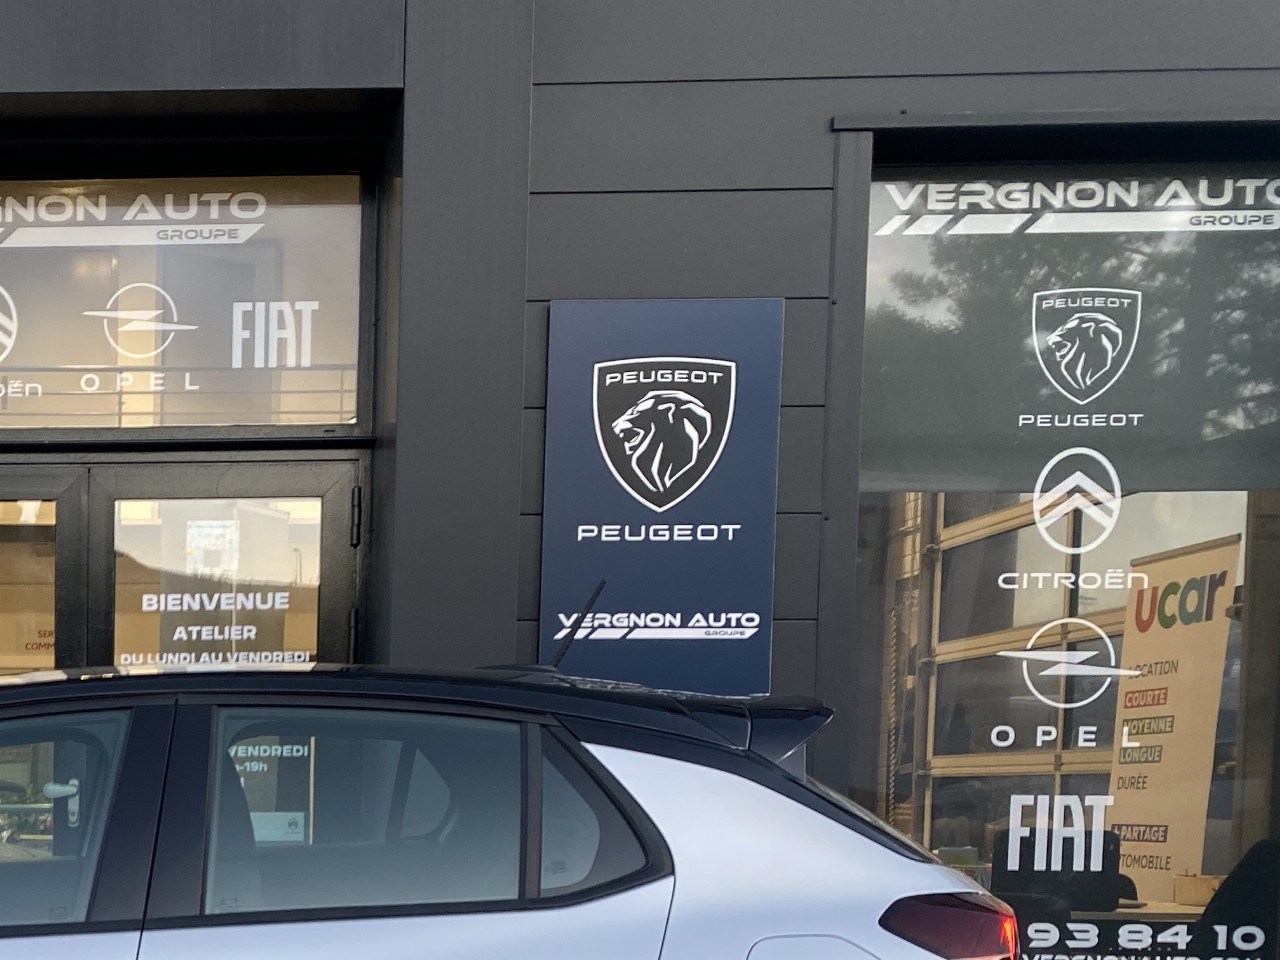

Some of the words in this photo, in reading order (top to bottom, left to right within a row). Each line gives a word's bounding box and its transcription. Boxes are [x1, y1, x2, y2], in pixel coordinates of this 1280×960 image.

[884, 180, 1138, 210] VERGNON
[122, 192, 267, 221] AUTO
[1189, 215, 1274, 226] GROUPE
[156, 229, 239, 240] GROUPE
[1042, 298, 1132, 309] PEUGEOT
[232, 301, 319, 368] FIAT
[80, 373, 200, 393] OPEL
[605, 370, 724, 386] PEUGEOT
[1019, 413, 1144, 427] PEUGEOT
[577, 525, 741, 541] PEUGEOT
[142, 592, 290, 612] BIENVENUE
[1135, 570, 1228, 633] ucar
[558, 612, 683, 628] VERGNON
[687, 612, 760, 628] AUTO
[173, 625, 257, 641] ATELIER
[120, 653, 144, 665] DU
[147, 652, 195, 665] LUNDI
[200, 651, 223, 664] AU
[226, 650, 310, 664] VENDREDI
[1126, 690, 1166, 707] COURTE
[990, 724, 1141, 748] OPEL
[1120, 747, 1161, 763] LONGUE
[1117, 773, 1148, 790] DURÉE
[1006, 794, 1115, 872] FIAT
[1120, 853, 1172, 871] TOMOBILE
[1027, 922, 1099, 949] 93
[1118, 923, 1193, 950] 84
[1213, 924, 1266, 951] 10
